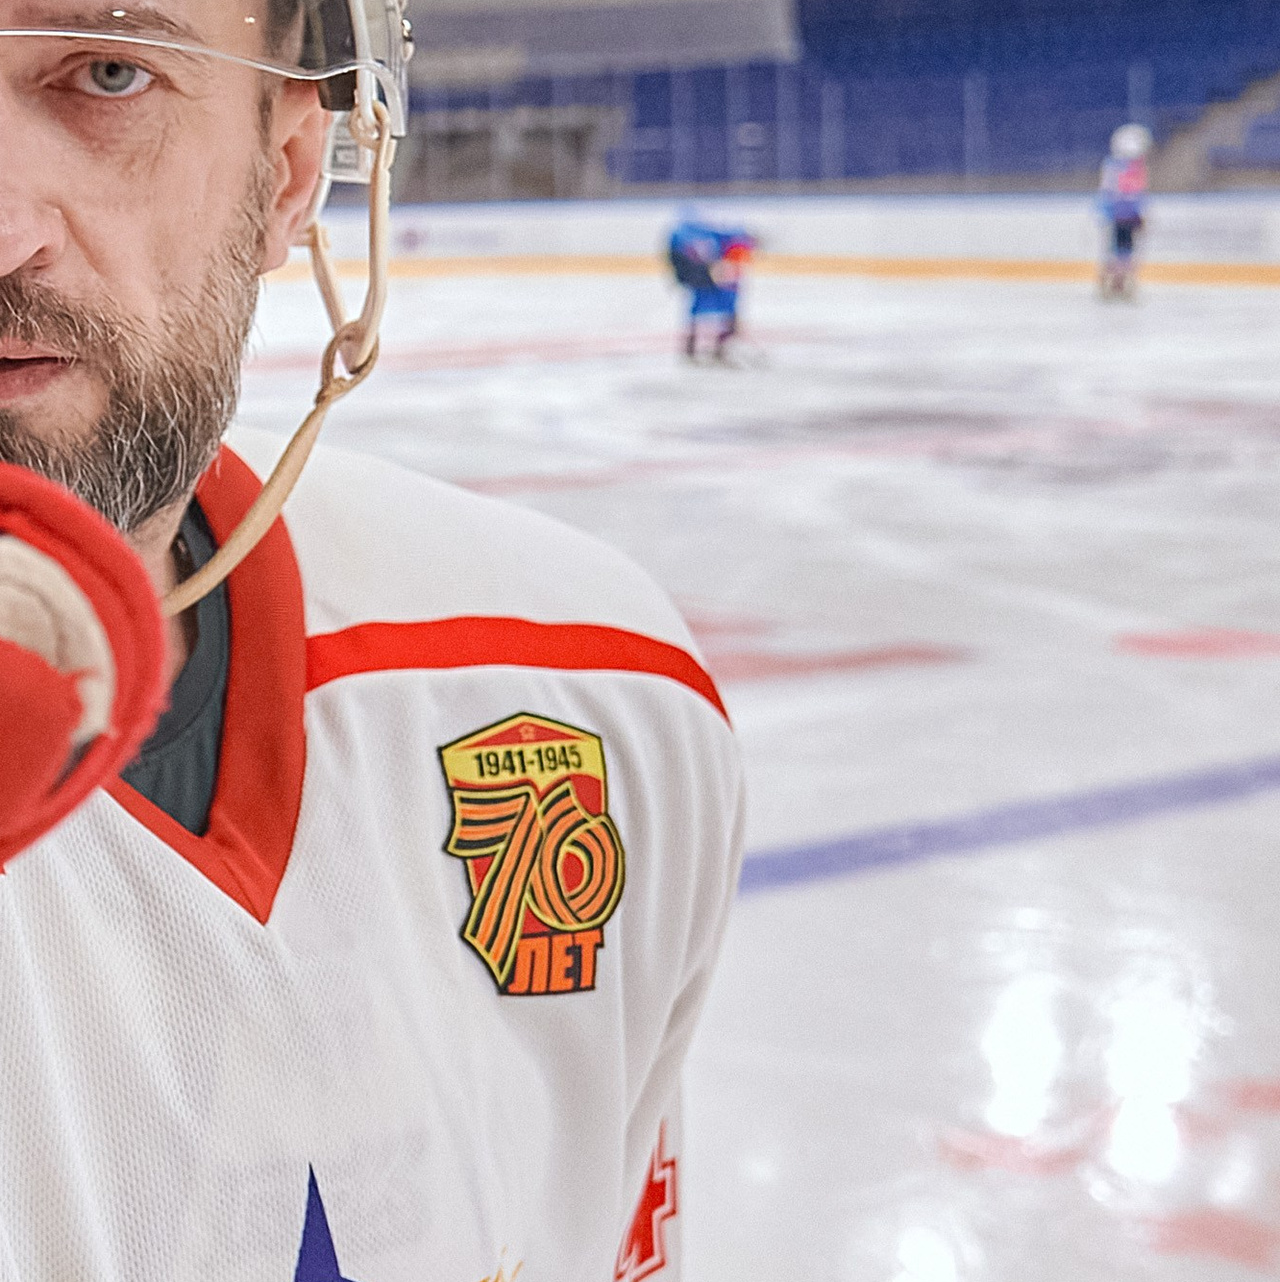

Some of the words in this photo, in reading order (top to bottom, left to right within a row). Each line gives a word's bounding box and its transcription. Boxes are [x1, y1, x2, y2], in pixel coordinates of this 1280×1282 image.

[473, 744, 584, 778] 1941-1945
[442, 781, 626, 987] 70
[506, 927, 604, 995] ЛЕТ
